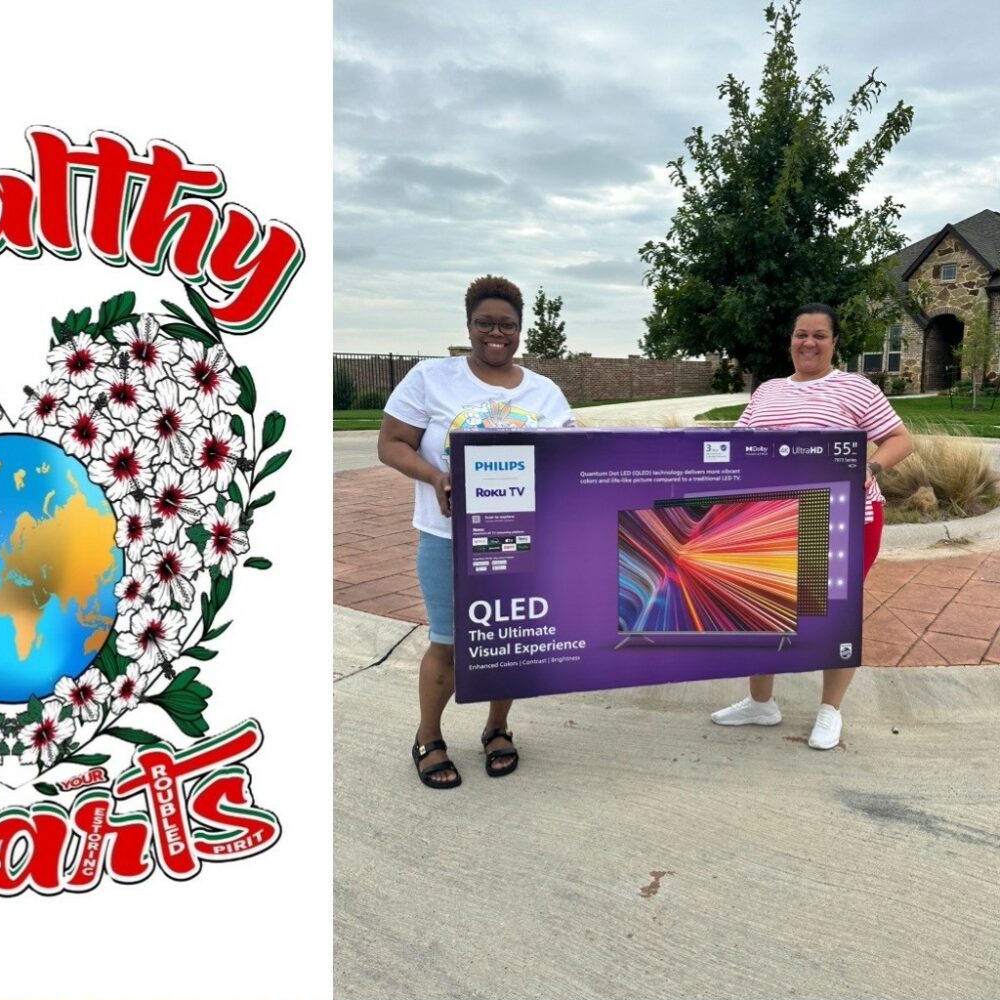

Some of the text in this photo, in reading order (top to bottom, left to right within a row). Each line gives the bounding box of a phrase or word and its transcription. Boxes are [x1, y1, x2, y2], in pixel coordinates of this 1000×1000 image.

[475, 461, 525, 471] PHILIPS
[476, 487, 525, 497] Roku TV
[468, 597, 549, 626] QLED
[468, 625, 556, 641] The Ultimate
[468, 640, 586, 658] Visual Experience
[469, 663, 499, 671] Enhanced
[522, 657, 547, 665] Contrast
[550, 655, 580, 663] Brightness
[58, 767, 107, 791] YOUR
[150, 764, 186, 857] ROUBLED
[83, 807, 107, 877] ESTORING
[213, 827, 266, 855] PIRIT
